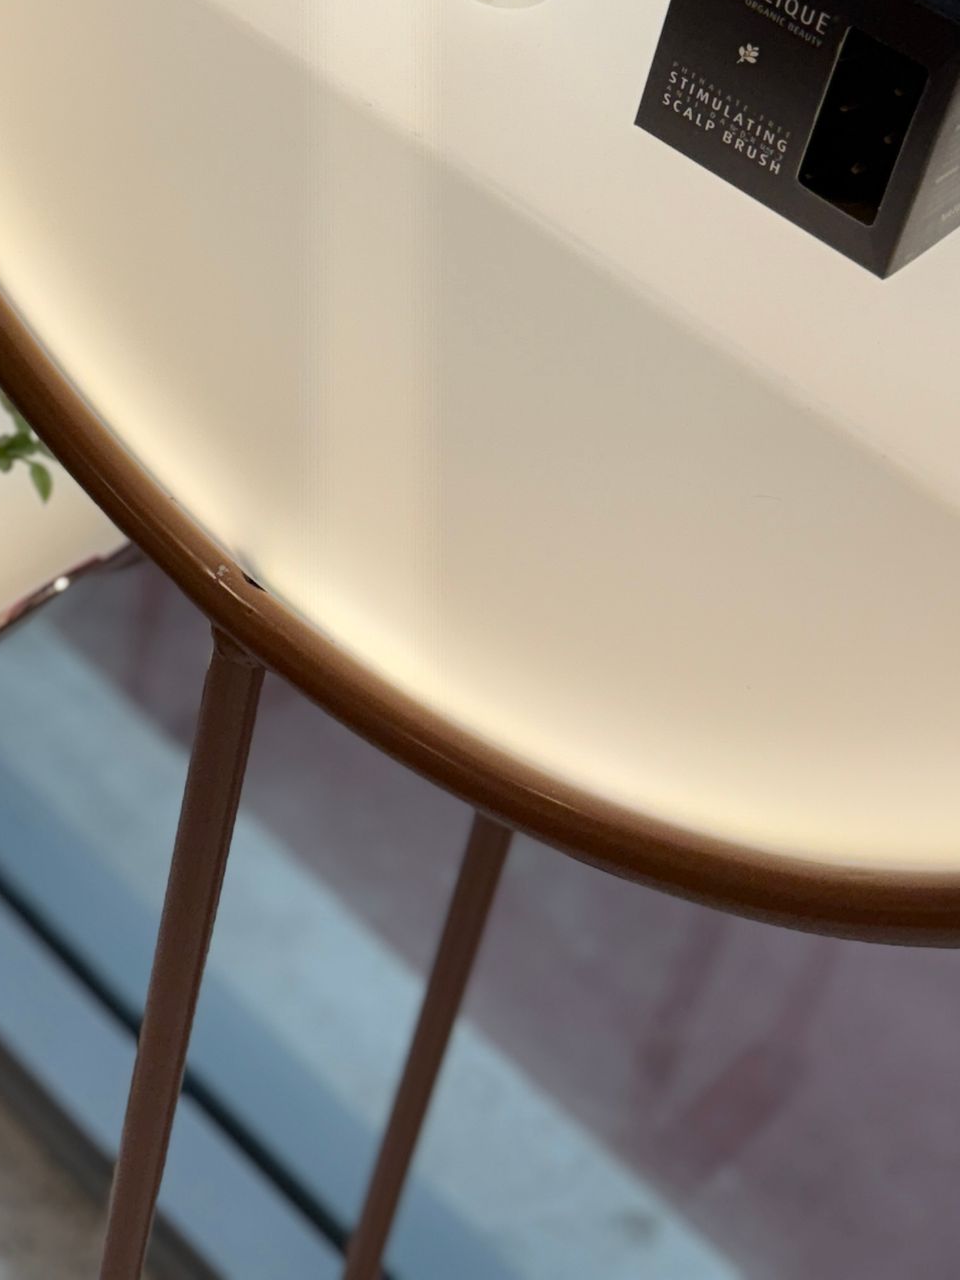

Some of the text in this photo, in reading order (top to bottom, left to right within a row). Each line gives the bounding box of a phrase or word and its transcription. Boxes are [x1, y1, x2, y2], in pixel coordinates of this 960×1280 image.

[787, 21, 823, 48] BEAUTY
[662, 92, 781, 176] SCALP BRUSH
[668, 70, 788, 153] STIMULATING
